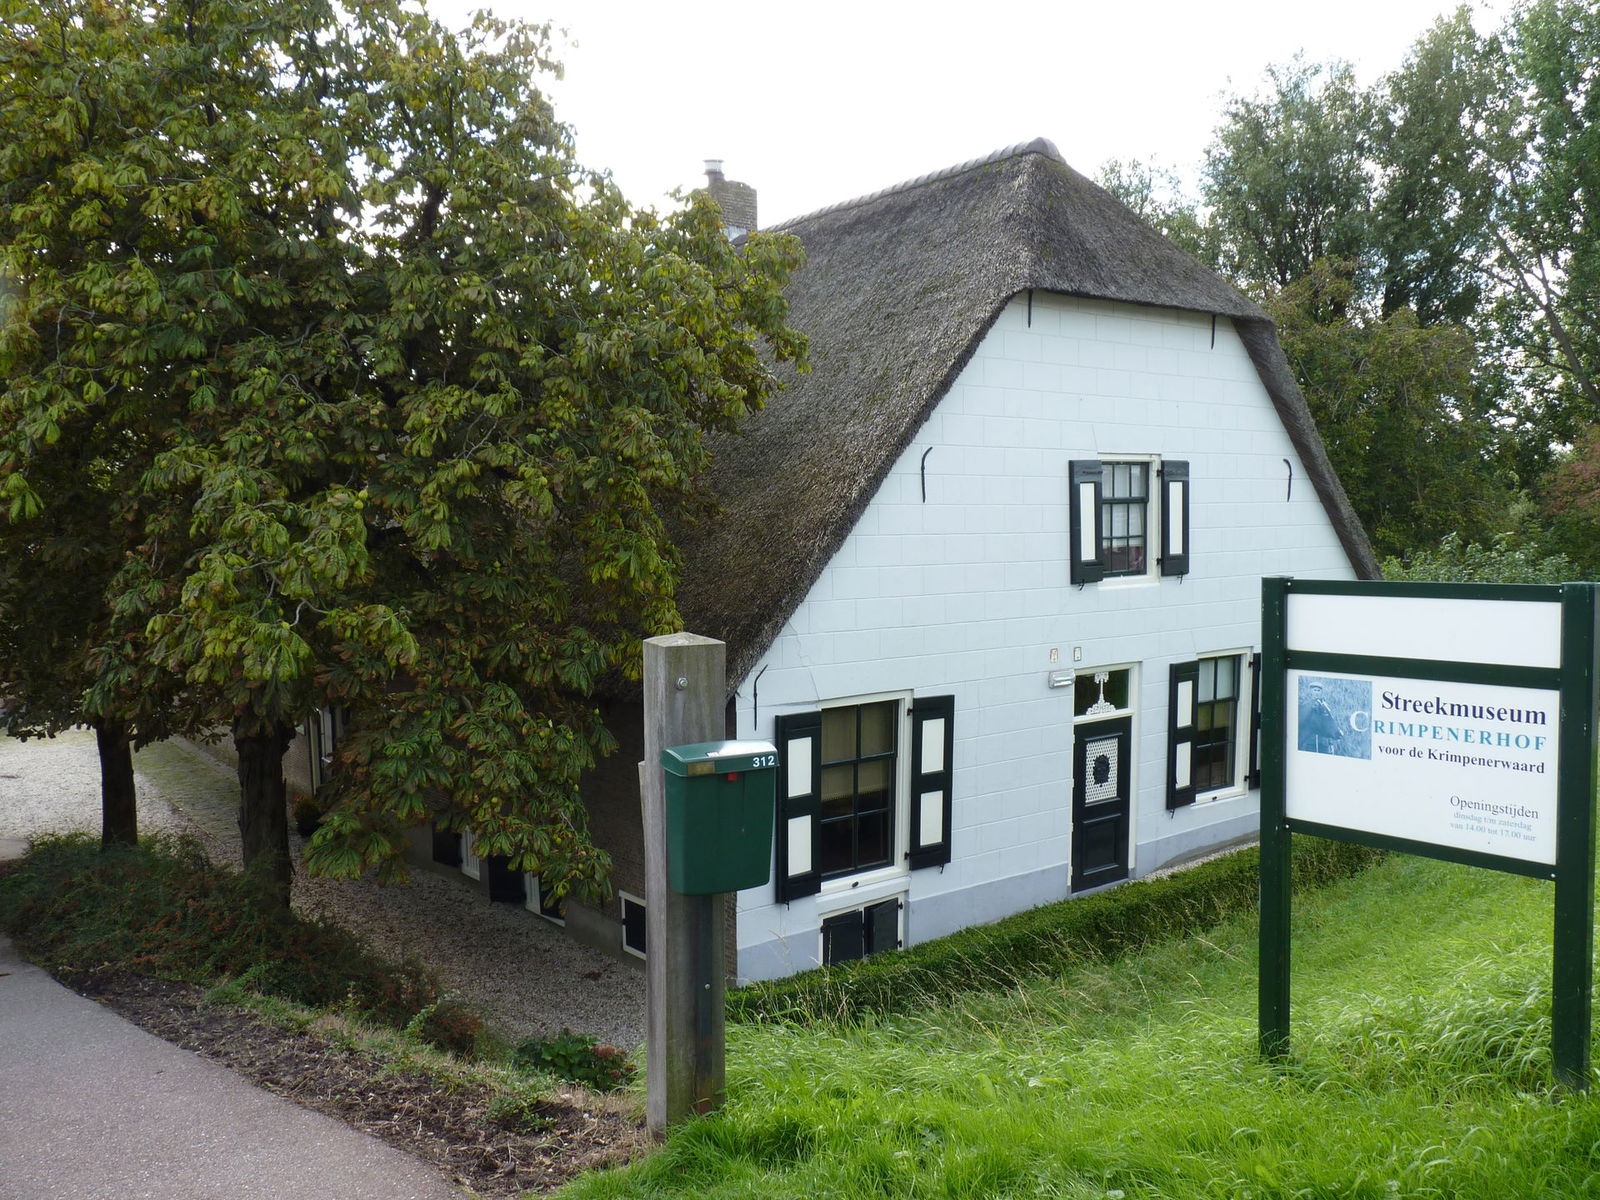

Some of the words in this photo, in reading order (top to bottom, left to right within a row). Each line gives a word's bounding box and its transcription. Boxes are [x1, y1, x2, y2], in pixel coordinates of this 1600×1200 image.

[1382, 690, 1547, 725] Streekmuseum
[1349, 711, 1547, 750] CRIMPENERHOF
[752, 755, 775, 767] 312
[1378, 745, 1406, 756] voor
[1409, 746, 1424, 759] de
[1428, 748, 1545, 774] Krimpenerwaard
[1450, 795, 1539, 819] Openingstijden
[1466, 823, 1486, 832] 14.00
[1488, 828, 1498, 836] tot
[1500, 829, 1521, 839] 17.00
